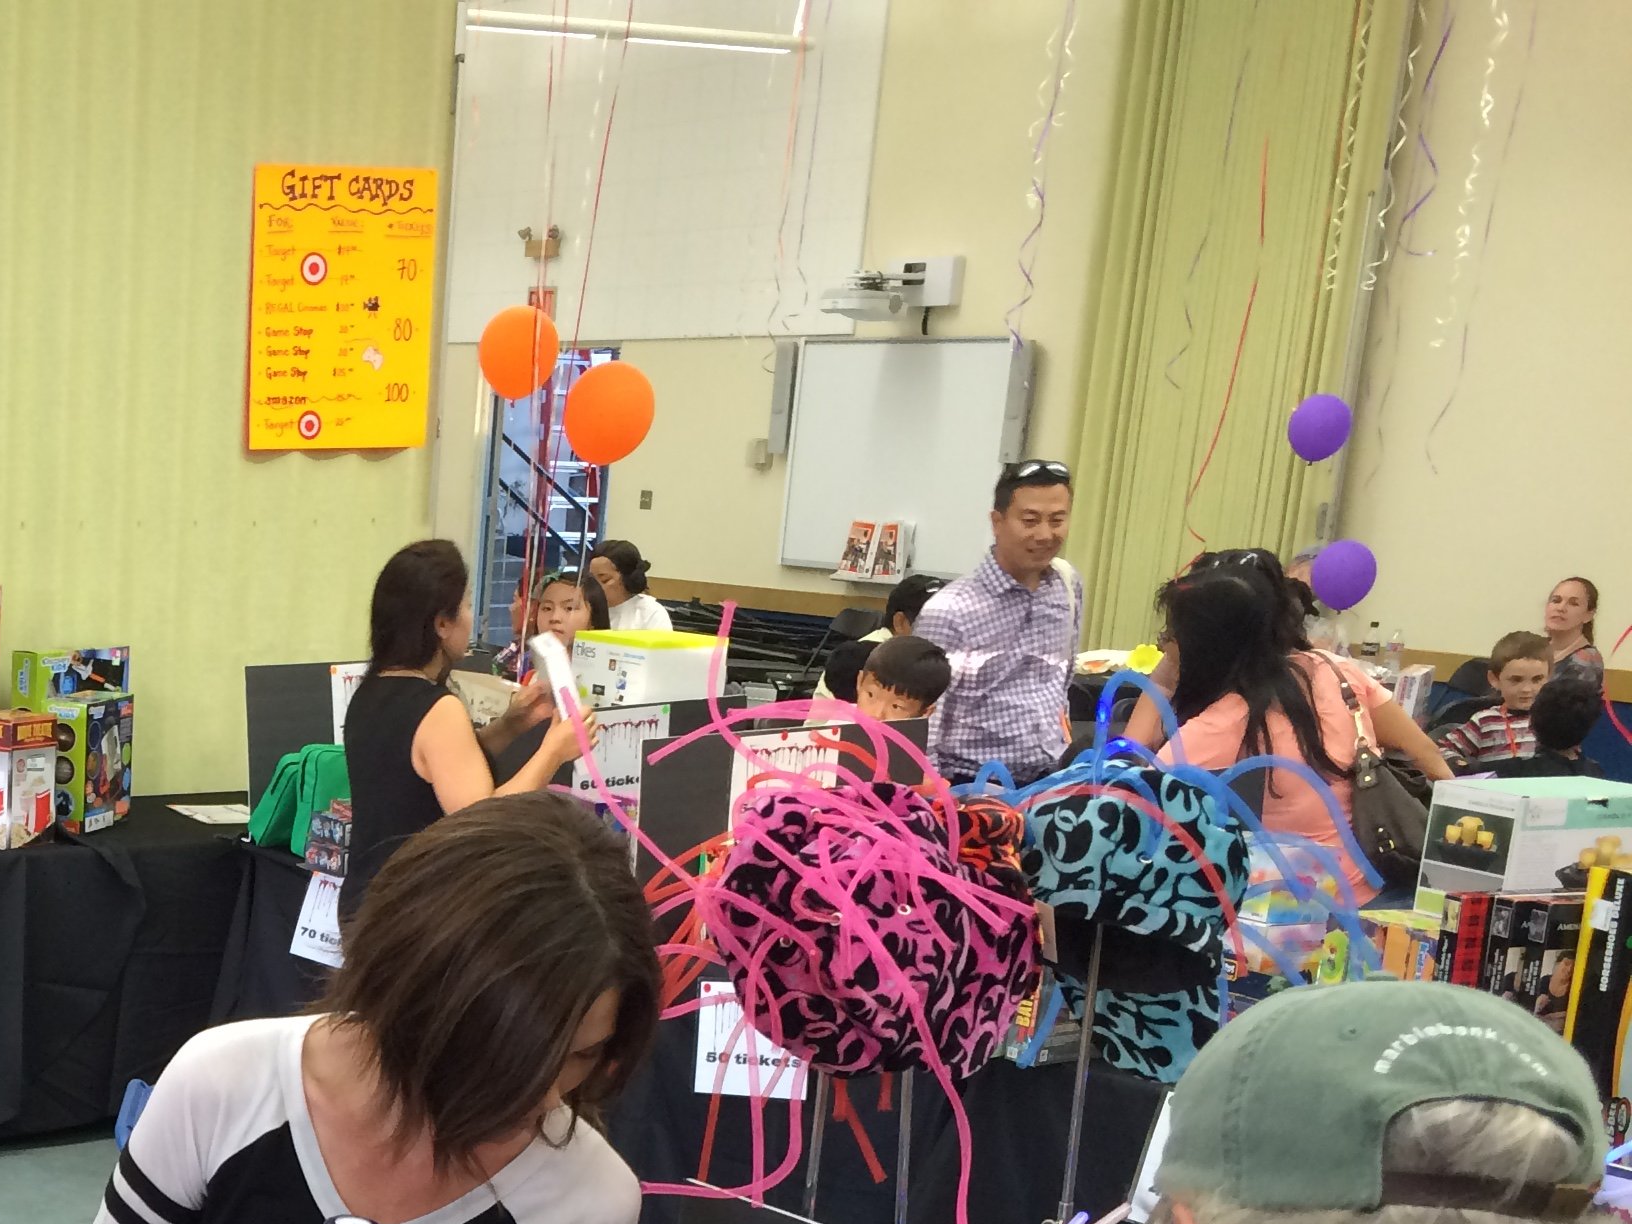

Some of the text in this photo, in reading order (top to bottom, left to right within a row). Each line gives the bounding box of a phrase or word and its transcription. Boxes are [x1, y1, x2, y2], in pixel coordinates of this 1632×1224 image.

[281, 169, 415, 207] GIFT CARDS
[397, 258, 417, 281] 70
[393, 318, 413, 342] 80
[385, 382, 409, 403] 100
[575, 642, 597, 659] tikes
[300, 926, 317, 939] 70
[706, 1051, 802, 1068] 50 tickets
